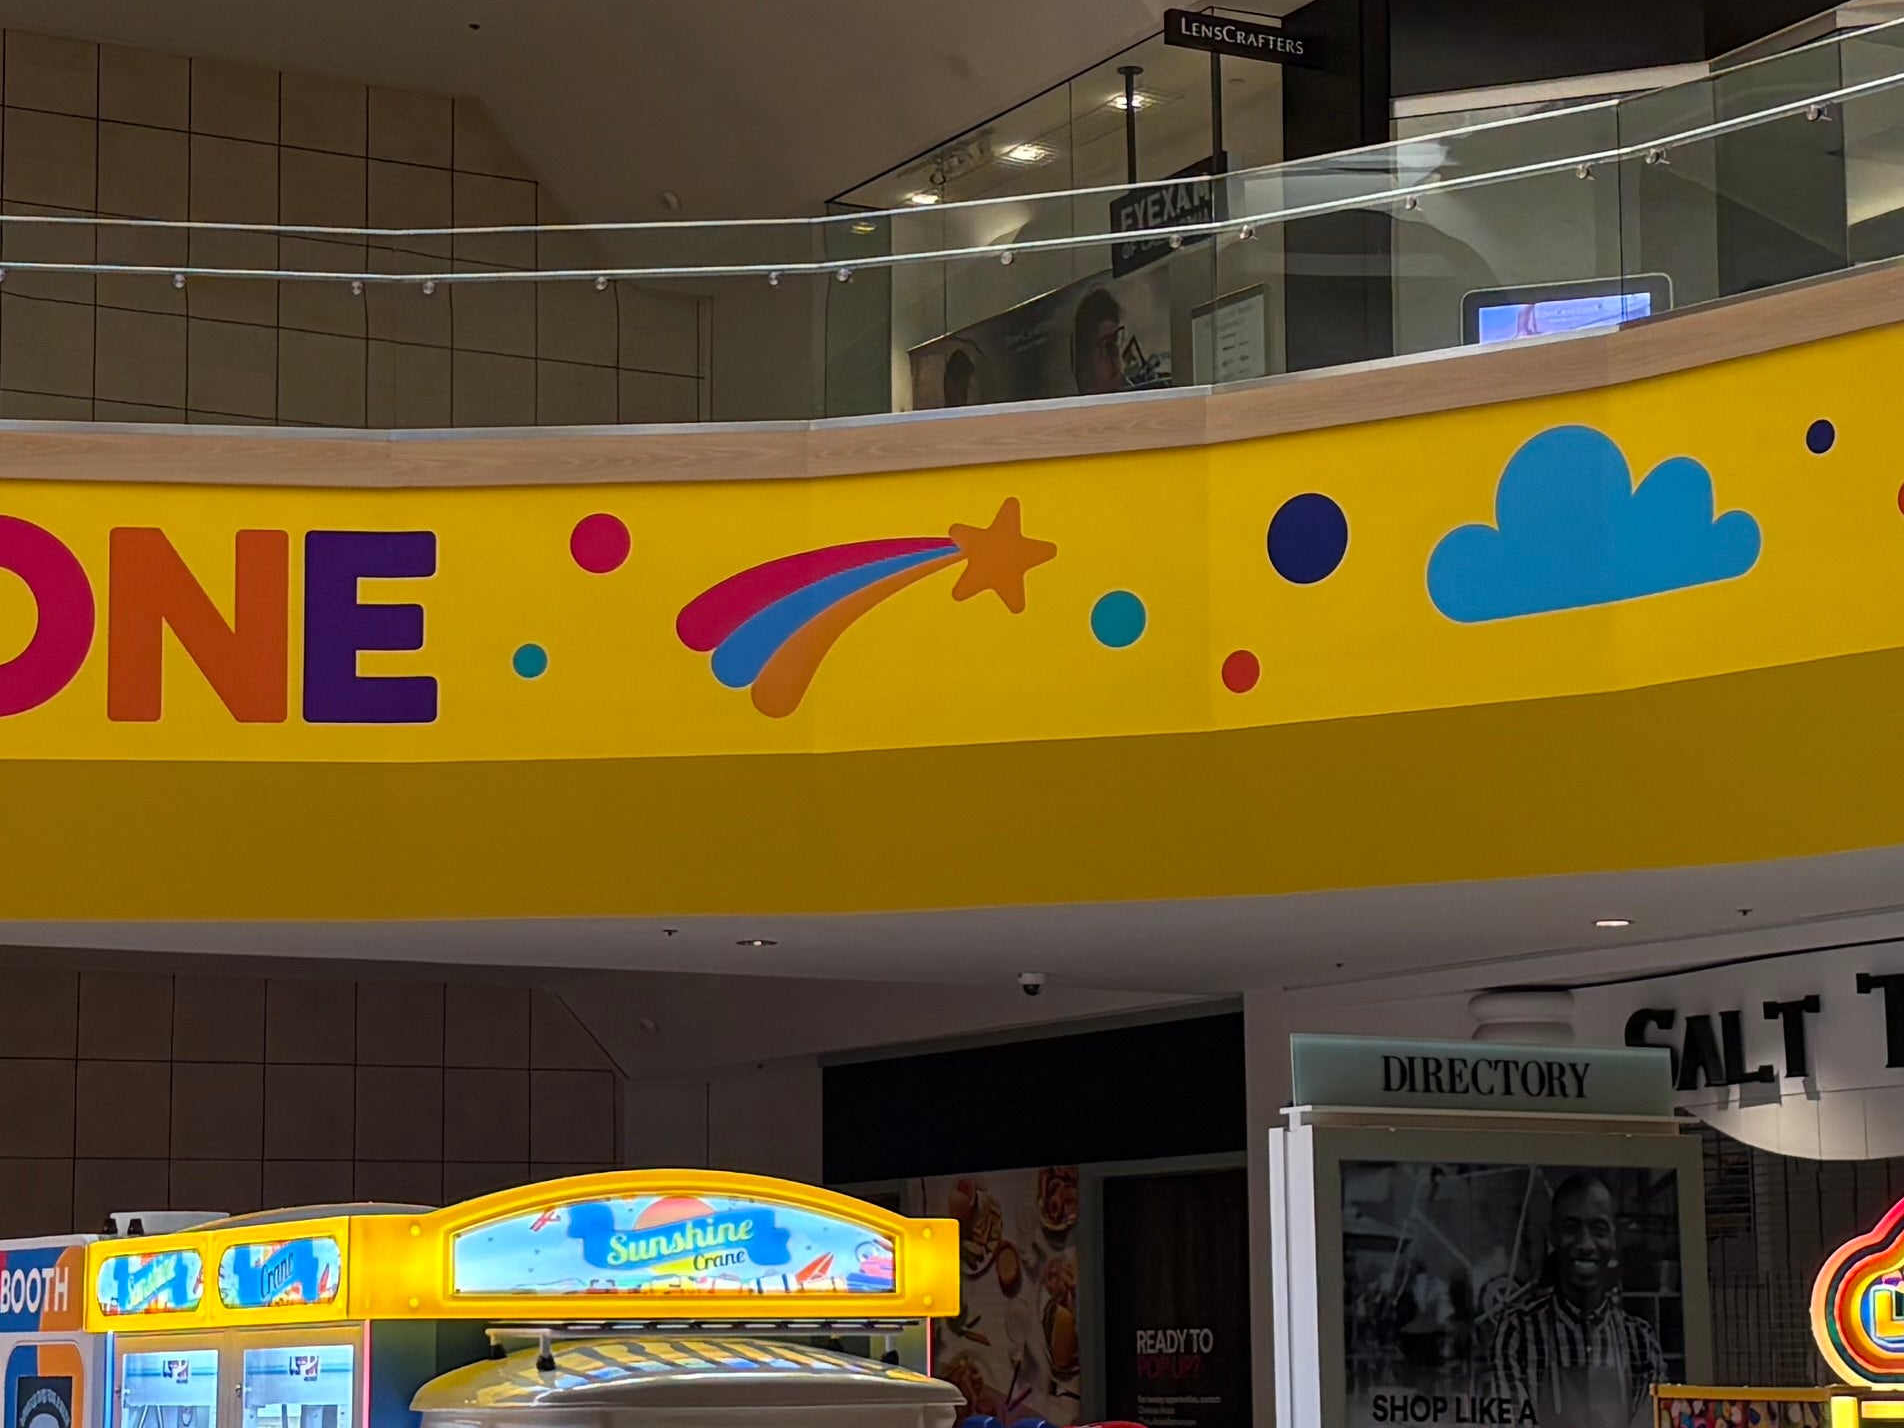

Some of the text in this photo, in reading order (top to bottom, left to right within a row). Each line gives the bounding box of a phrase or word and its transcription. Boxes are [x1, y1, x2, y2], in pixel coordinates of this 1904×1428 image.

[1625, 995, 1821, 1090] SALT
[1382, 1054, 1593, 1099] DIRECTORY
[607, 1214, 755, 1267] Sunshine
[693, 1248, 747, 1273] Crane
[0, 1266, 69, 1315] BOOTH
[1136, 1327, 1214, 1354] READY TO
[1372, 1394, 1538, 1424] SHOP LIKE A
